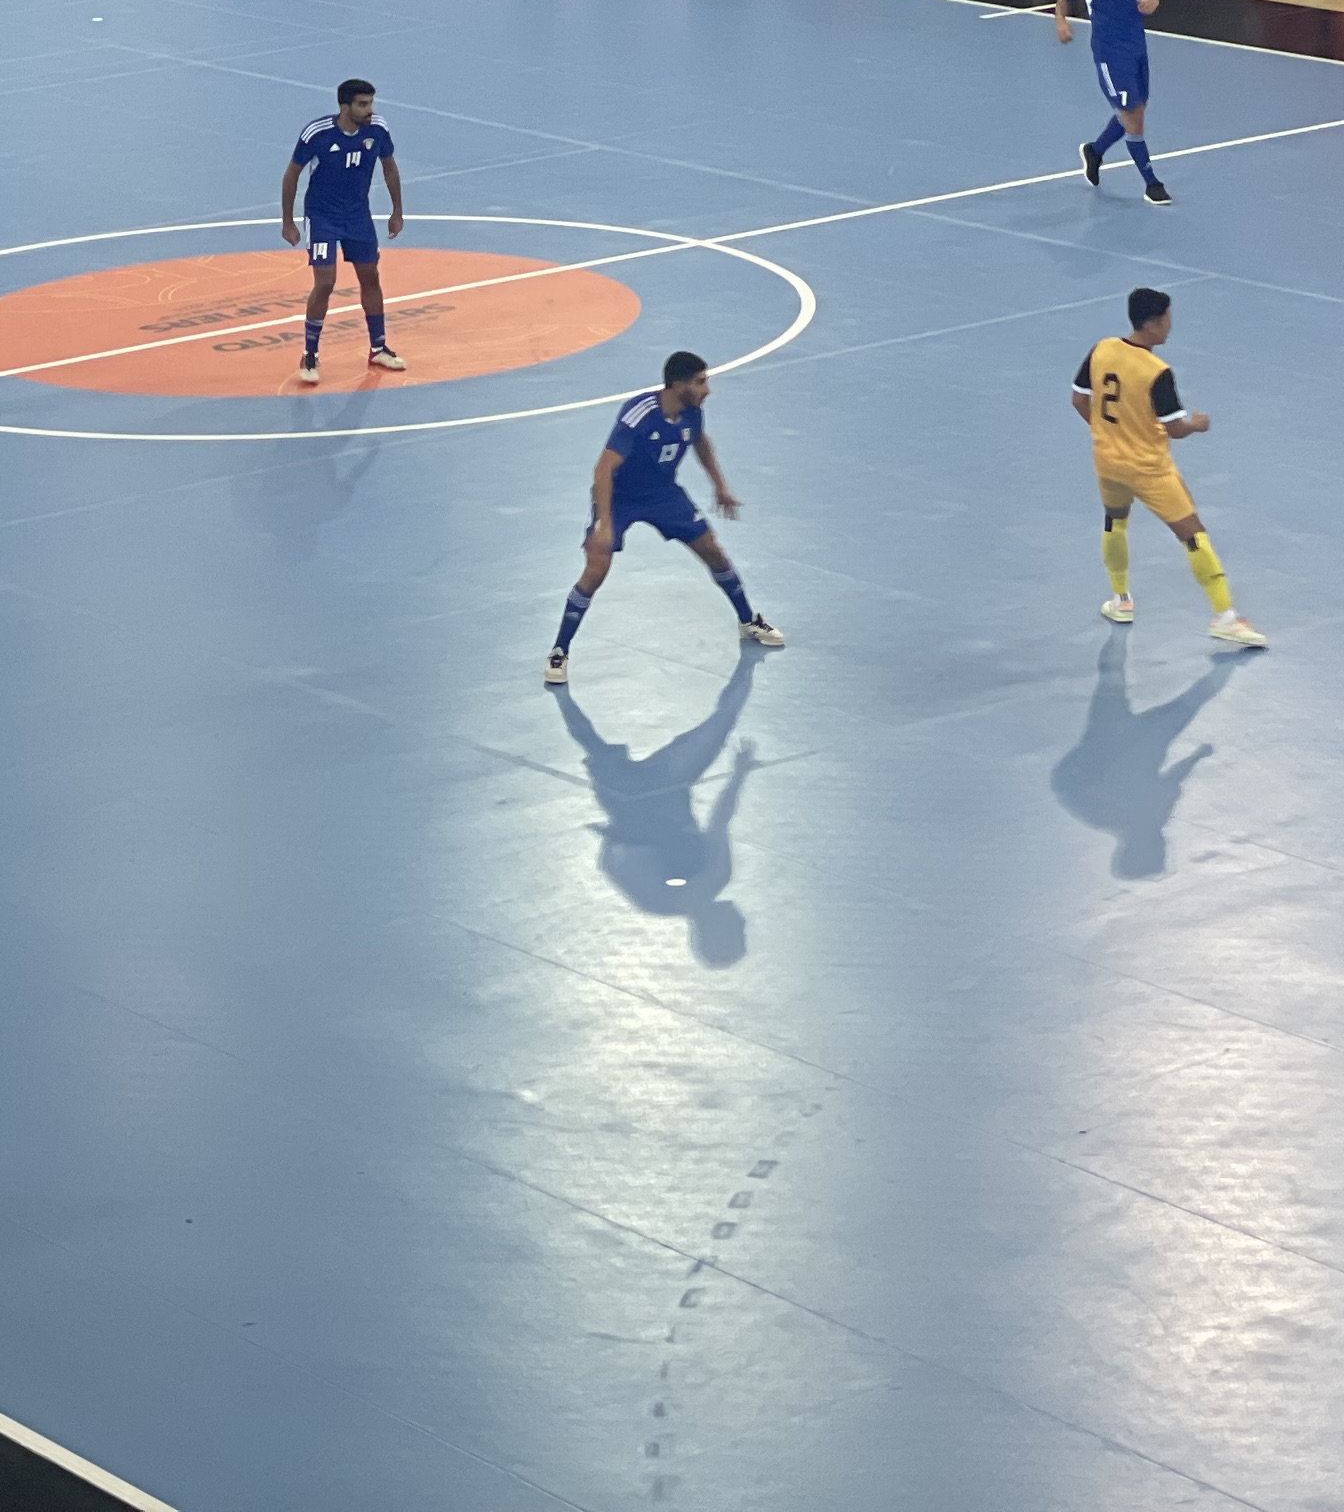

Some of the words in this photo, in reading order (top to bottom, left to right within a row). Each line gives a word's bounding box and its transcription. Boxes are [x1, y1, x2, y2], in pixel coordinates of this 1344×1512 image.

[1118, 90, 1128, 107] 7
[345, 150, 362, 169] 14
[312, 242, 329, 261] 14
[1101, 373, 1121, 424] 2
